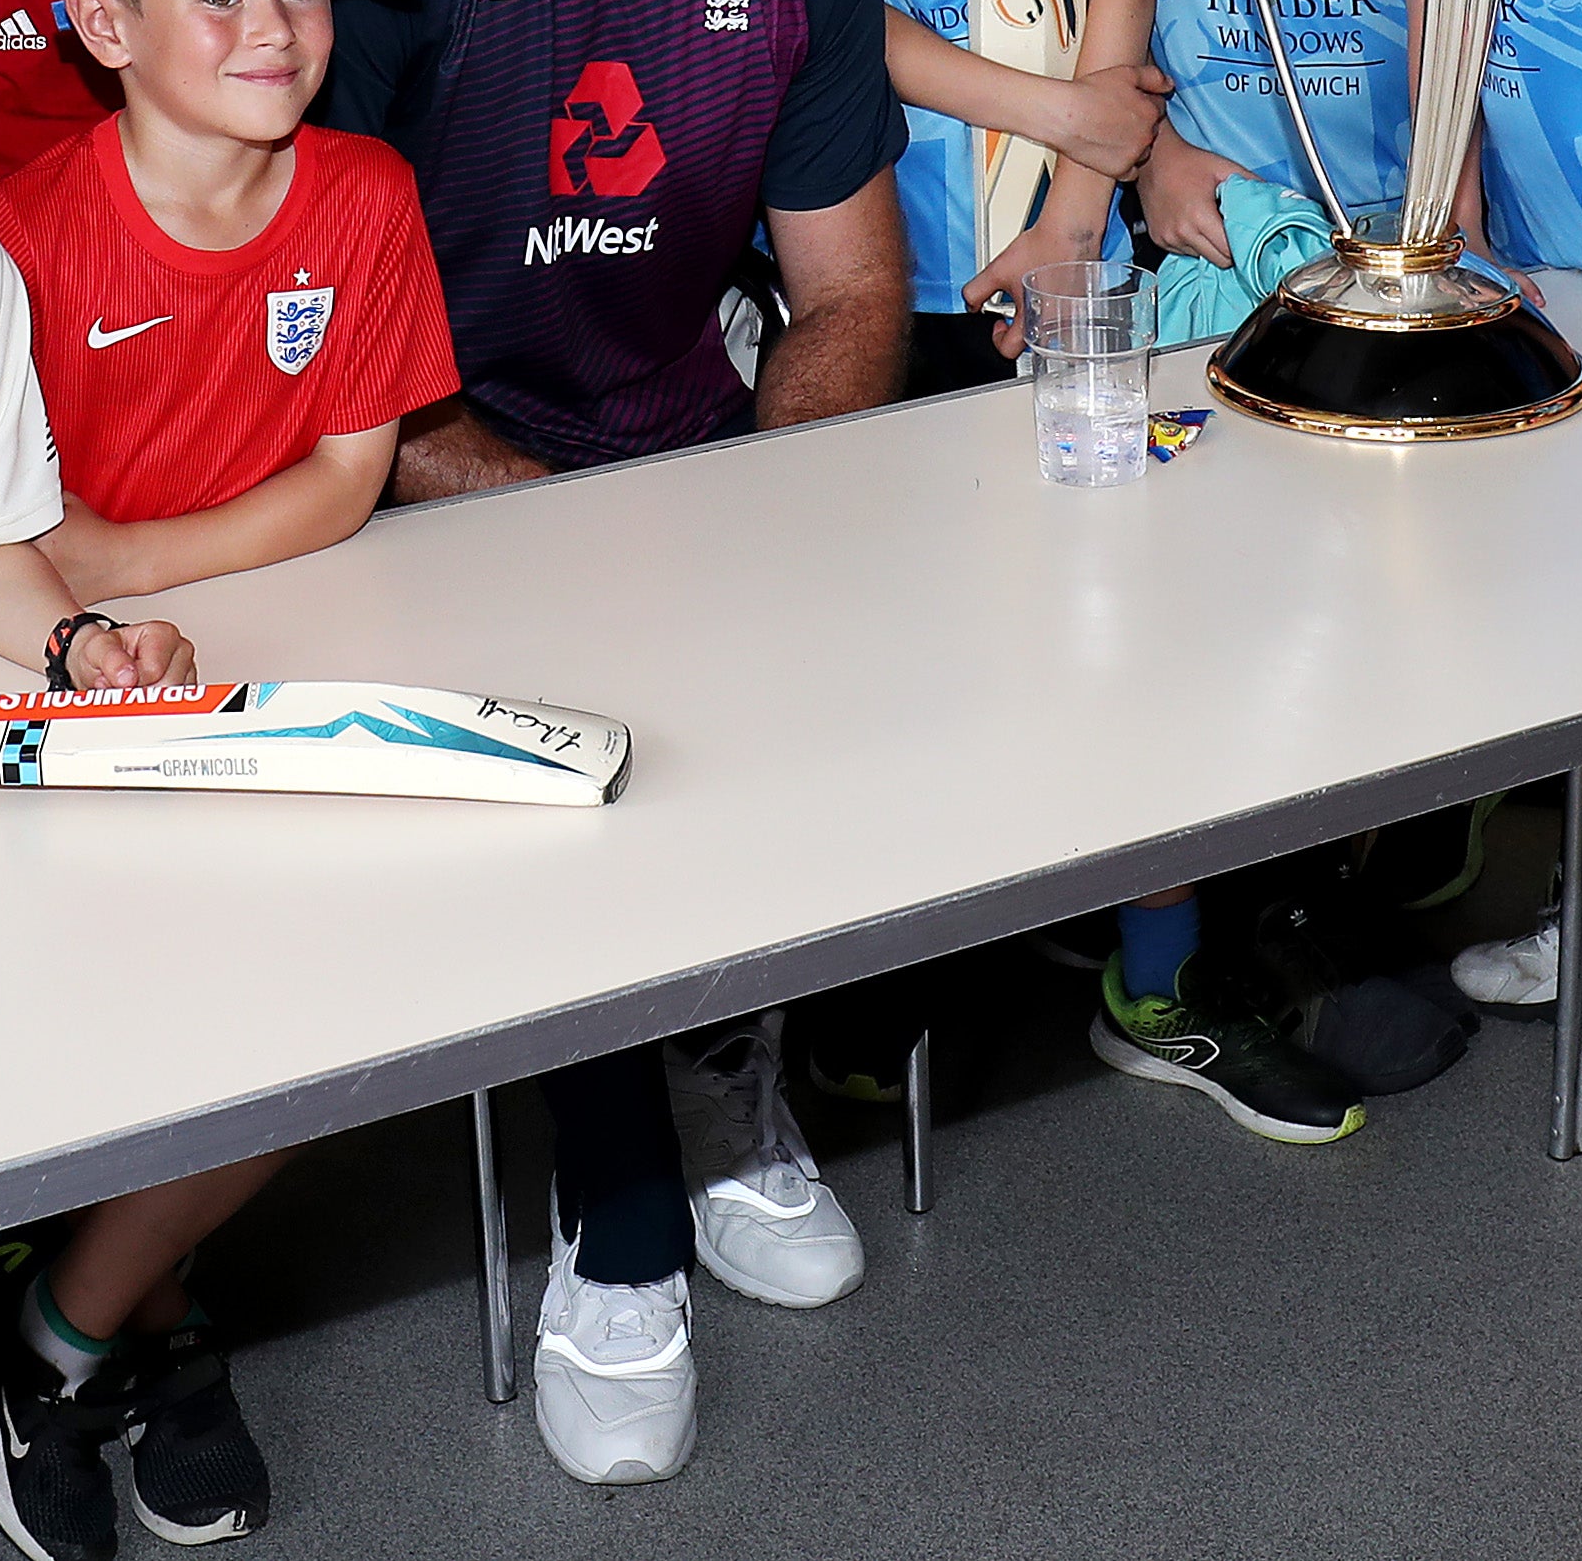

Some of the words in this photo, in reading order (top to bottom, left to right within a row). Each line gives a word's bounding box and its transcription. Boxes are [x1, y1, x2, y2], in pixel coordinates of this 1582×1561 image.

[1225, 72, 1250, 93] OF
[1259, 75, 1361, 97] DUWICH
[524, 215, 660, 267] NtWest
[162, 757, 259, 778] GRAY-NICOLLS
